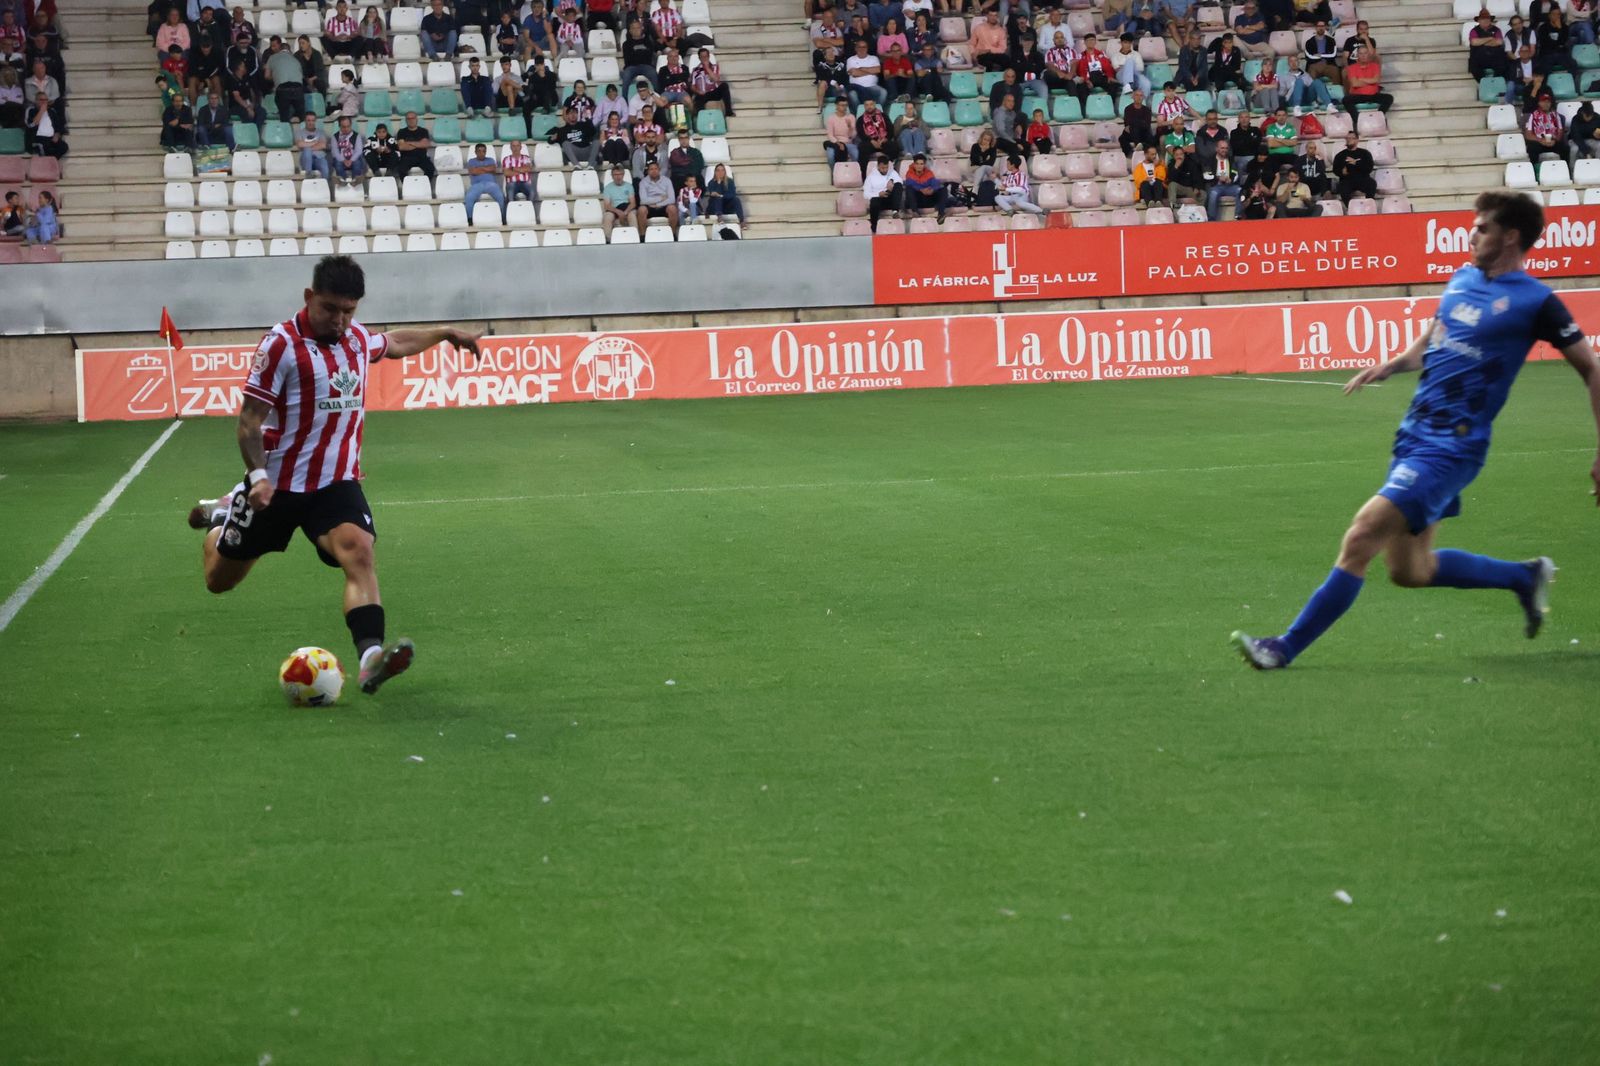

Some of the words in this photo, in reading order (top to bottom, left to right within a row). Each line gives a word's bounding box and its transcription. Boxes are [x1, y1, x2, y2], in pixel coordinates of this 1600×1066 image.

[1186, 238, 1359, 259] RESTAURANTE
[1148, 262, 1250, 279] PALACIO
[1261, 260, 1306, 274] DEL
[1317, 255, 1398, 271] DUERO
[1562, 256, 1572, 268] 7
[899, 278, 919, 288] LA
[923, 274, 990, 287] FÁBRICA
[1019, 274, 1039, 284] DE
[1043, 273, 1063, 283] LA
[1067, 272, 1098, 283] LUZ
[1281, 307, 1332, 356] La
[402, 339, 562, 375] FUNDACIÓN
[995, 316, 1045, 367] La
[1058, 316, 1213, 381] Opinión
[707, 332, 757, 380] La
[771, 329, 925, 392] Opinión
[1299, 357, 1317, 370] El
[1322, 356, 1376, 369] Correo
[1012, 369, 1028, 381] El
[1032, 368, 1088, 380] Correo
[1104, 365, 1123, 378] de
[1126, 364, 1189, 377] Zamora
[725, 381, 741, 394] El
[745, 381, 801, 393] Correo
[817, 377, 836, 390] de
[839, 375, 903, 389] Zamora
